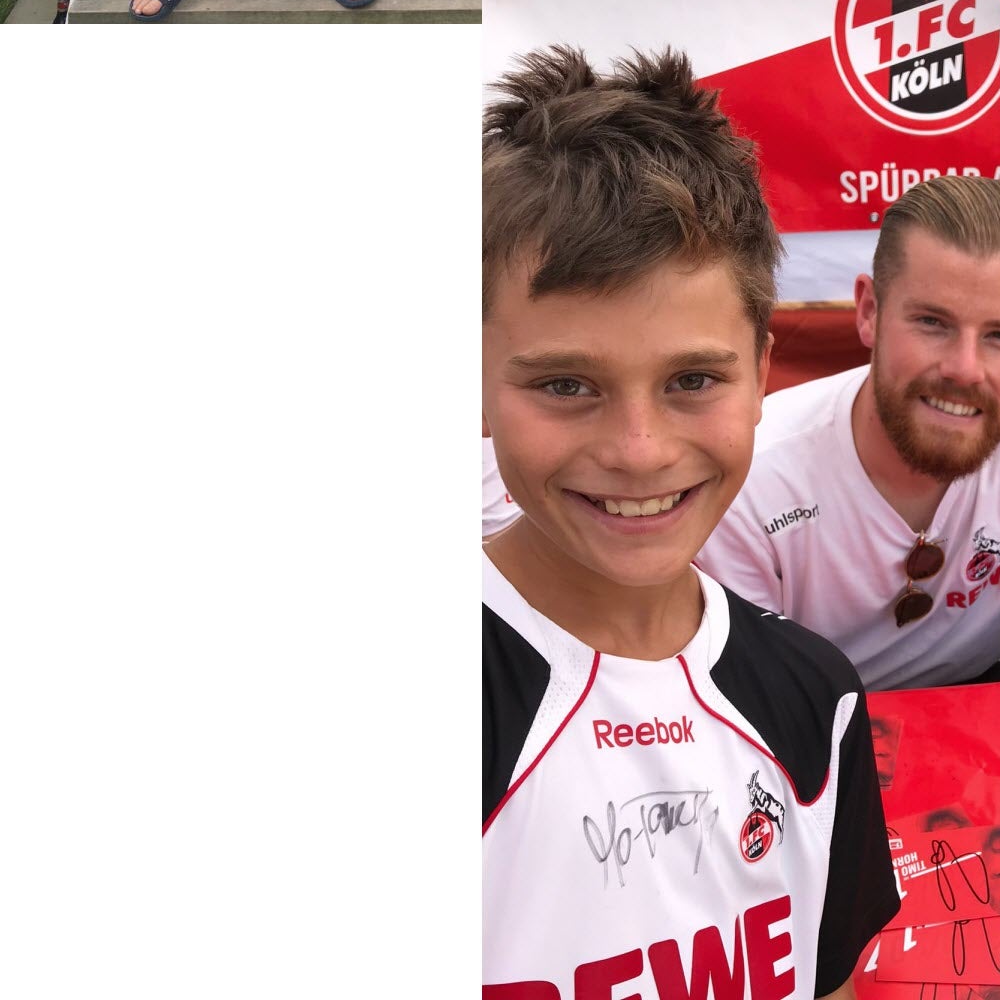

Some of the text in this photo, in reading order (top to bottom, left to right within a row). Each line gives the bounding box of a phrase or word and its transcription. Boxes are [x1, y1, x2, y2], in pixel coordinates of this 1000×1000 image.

[890, 60, 964, 102] KÖLN
[839, 162, 981, 204] SPÜR
[764, 503, 820, 535] uhlsport
[592, 715, 696, 749] Reebok
[901, 860, 927, 877] TIMO
